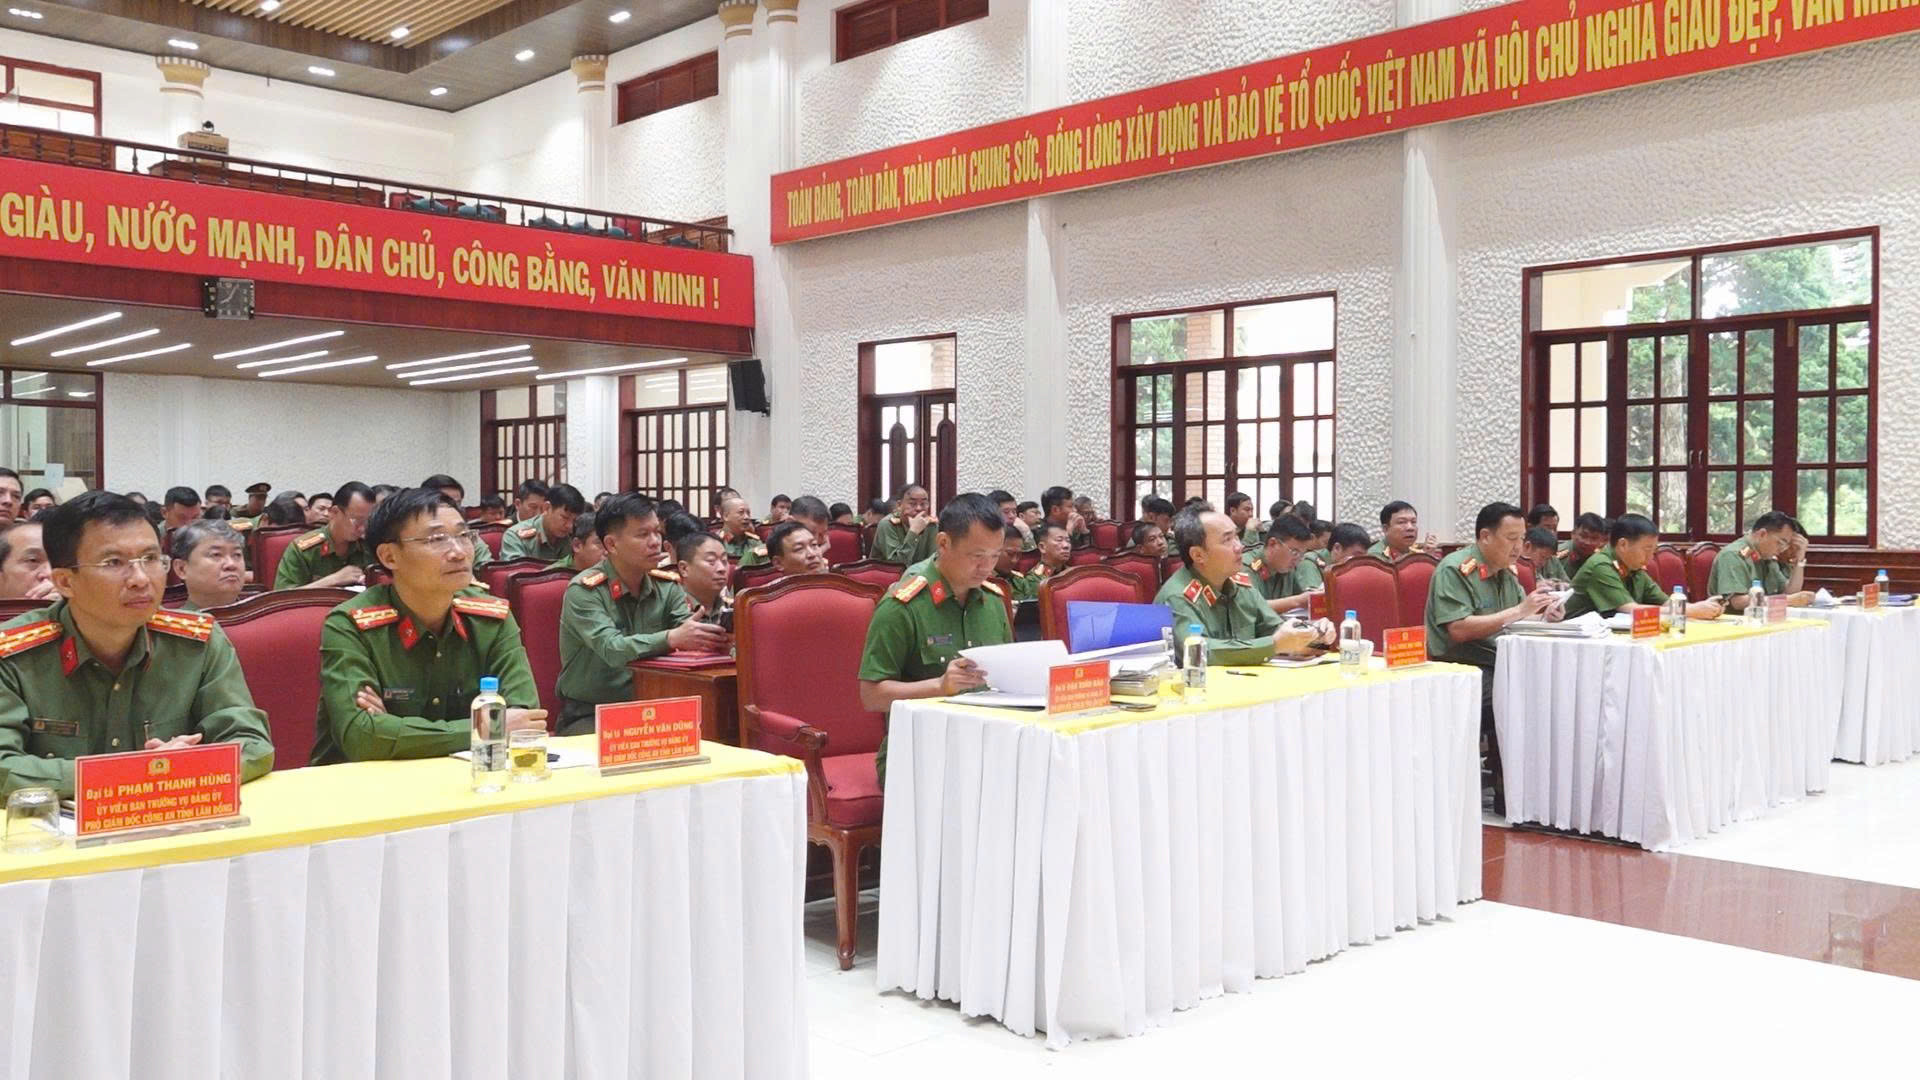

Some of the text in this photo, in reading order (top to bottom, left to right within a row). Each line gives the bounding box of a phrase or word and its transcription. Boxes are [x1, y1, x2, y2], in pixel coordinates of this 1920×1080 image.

[787, 181, 812, 227] TOÀN
[814, 171, 843, 222] ĐẢNG,
[846, 167, 872, 216] TOÀN
[903, 155, 932, 205] TOÀN
[935, 147, 966, 203] QUÂN
[970, 143, 1010, 192] CHUNG
[1013, 130, 1042, 185] SỨC,
[1046, 117, 1082, 178] ĐỒNG
[1086, 113, 1121, 170] LÒNG
[1125, 105, 1154, 163] XÂY
[1158, 102, 1198, 165] DỰNG
[1203, 87, 1223, 147] VÀ
[1227, 75, 1259, 143] BẢO
[1264, 73, 1284, 145] VỆ
[1289, 57, 1311, 131] TỔ
[1314, 50, 1361, 131] QUỐC
[1366, 48, 1405, 124] VIỆT
[1410, 46, 1455, 107] NAM
[1460, 27, 1488, 97] XÃ
[1495, 19, 1529, 100] HỘI
[1535, 0, 1579, 83] CHỦ
[0, 185, 94, 252] GIÀU,
[107, 201, 197, 255] NƯỚC
[208, 217, 304, 274] MẠNH,
[315, 223, 373, 273] DÂN
[382, 229, 444, 288] CHỦ,
[453, 240, 519, 288] CÔNG
[527, 242, 595, 303] BẰNG,
[602, 259, 646, 301] VĂN
[653, 270, 705, 308] MINH
[118, 782, 153, 798] PHẠM
[157, 777, 196, 792] THANH
[200, 773, 232, 785] HÙNG
